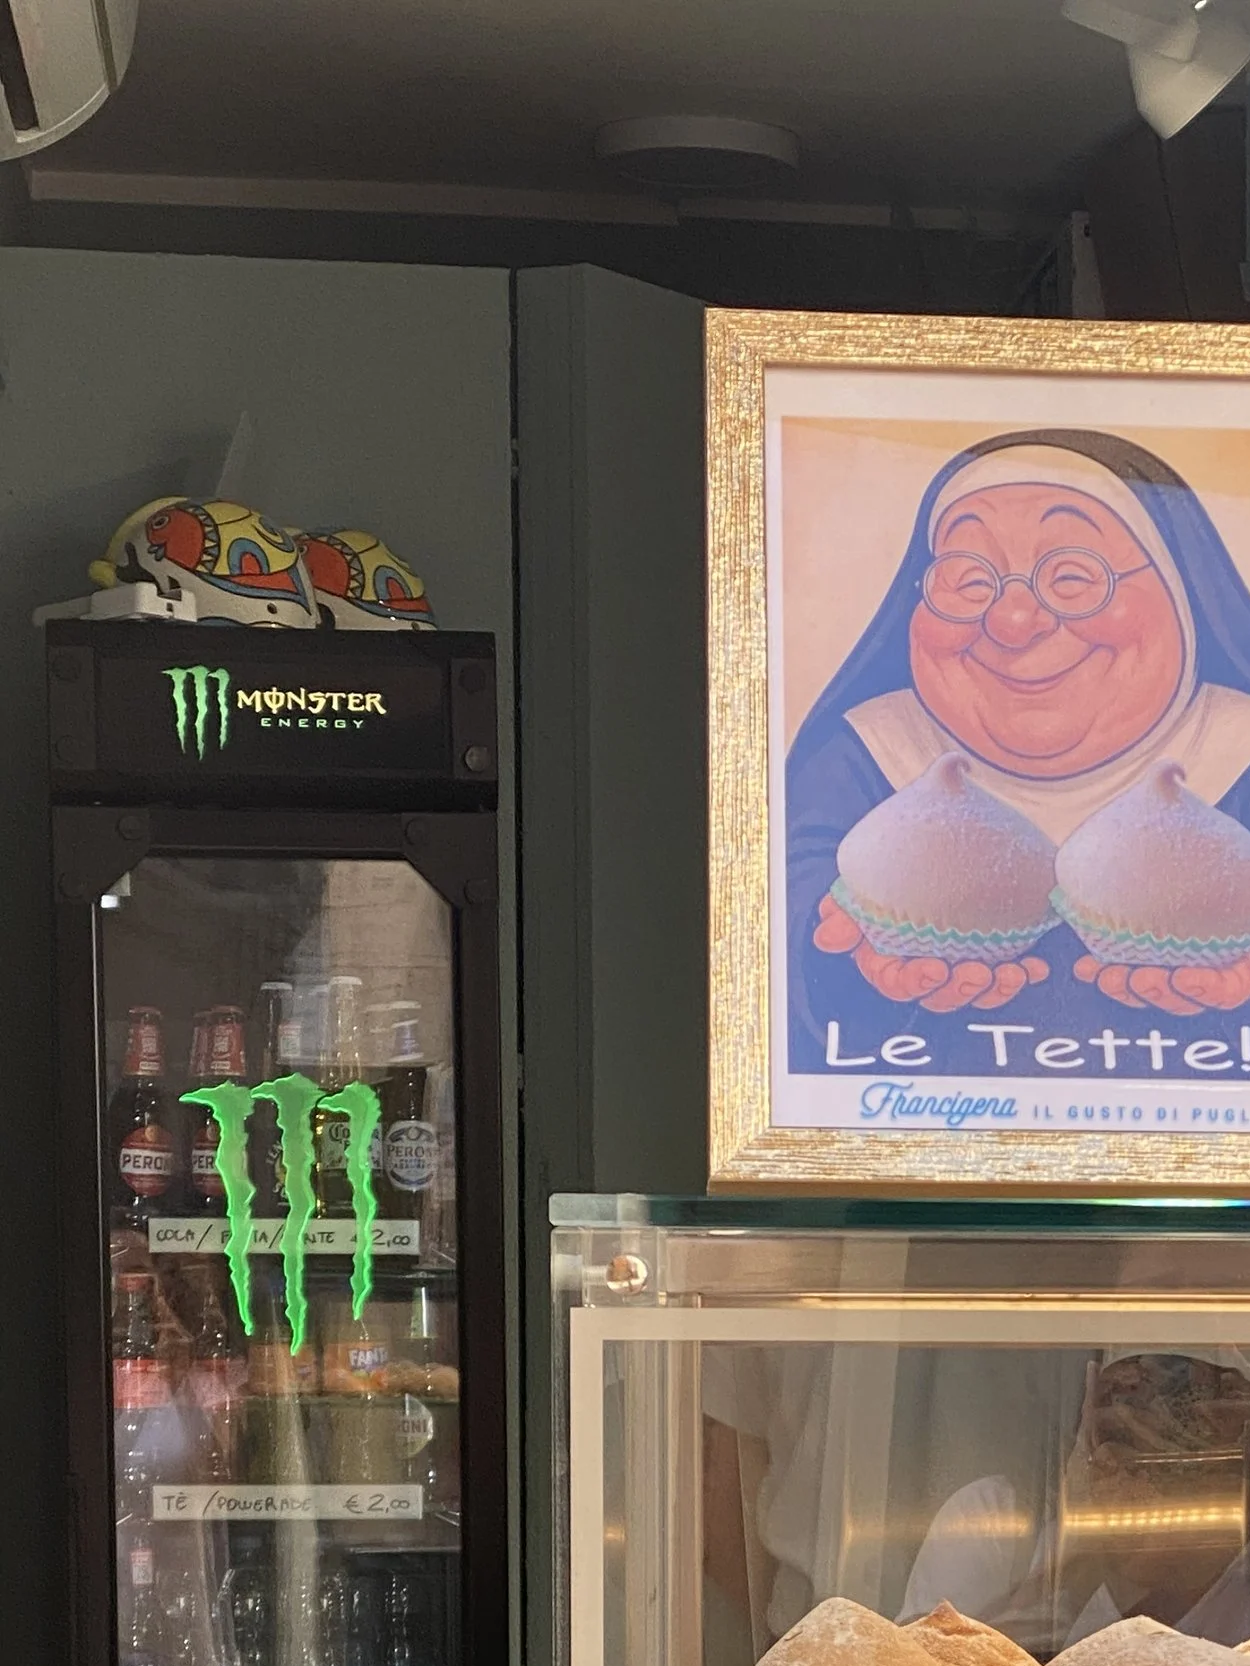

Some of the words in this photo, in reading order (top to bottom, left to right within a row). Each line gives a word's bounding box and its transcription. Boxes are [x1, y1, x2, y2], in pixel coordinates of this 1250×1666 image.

[260, 717, 364, 729] ENERGY
[826, 1020, 932, 1066] Le
[860, 1081, 1018, 1127] Francigena
[1033, 1104, 1054, 1119] IL
[1067, 1105, 1143, 1121] GUSTO
[1156, 1107, 1178, 1121] DI
[122, 1153, 171, 1171] PERO
[344, 1500, 361, 1513] €
[366, 1493, 411, 1513] 2,00
